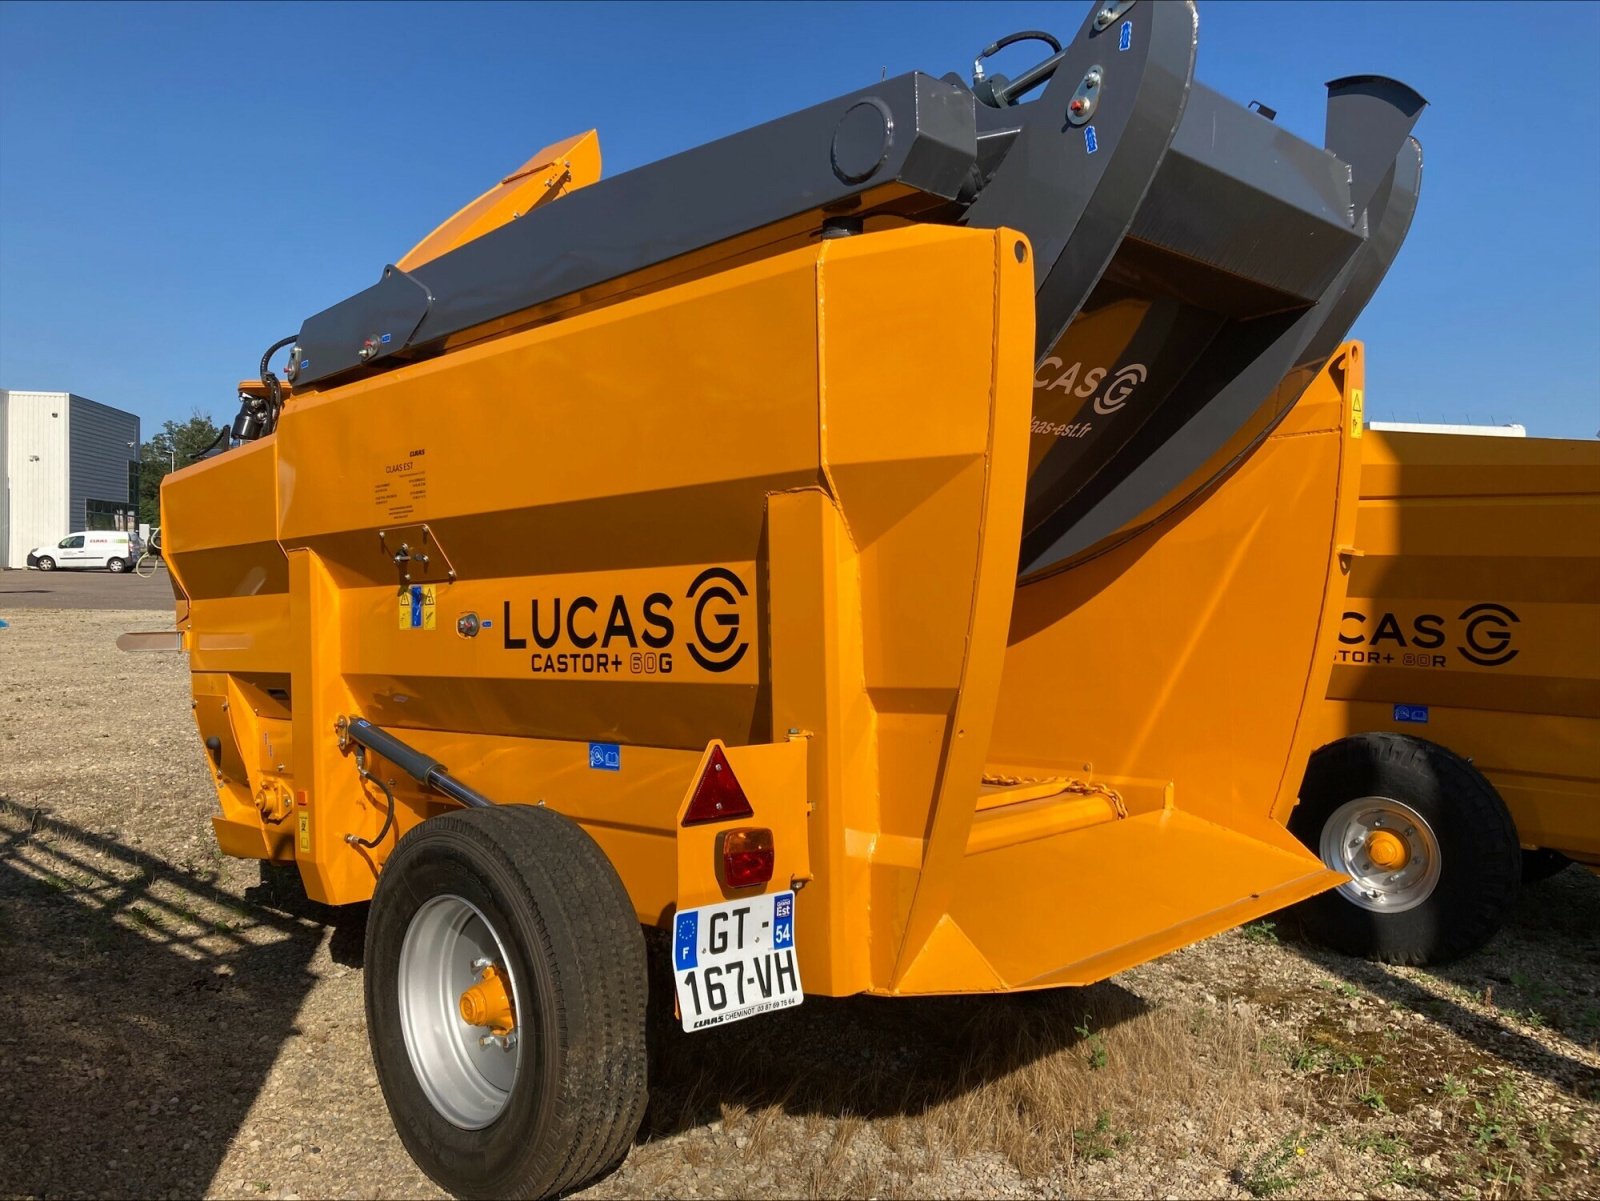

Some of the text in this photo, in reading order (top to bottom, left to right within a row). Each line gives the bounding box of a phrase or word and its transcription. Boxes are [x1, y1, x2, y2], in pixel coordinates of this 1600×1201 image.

[409, 449, 425, 457] CLAAS
[385, 461, 414, 473] CLAAS EST
[504, 592, 675, 649] LUCAS
[531, 652, 673, 674] CASTOR+ 60G
[1334, 650, 1447, 668] TOR+ 80R
[776, 905, 791, 917] Est
[775, 923, 791, 943] 54
[682, 947, 690, 960] F
[684, 950, 797, 1016] 167-VH
[693, 1015, 725, 1029] CLAAS
[725, 1008, 755, 1021] CHEMINOT
